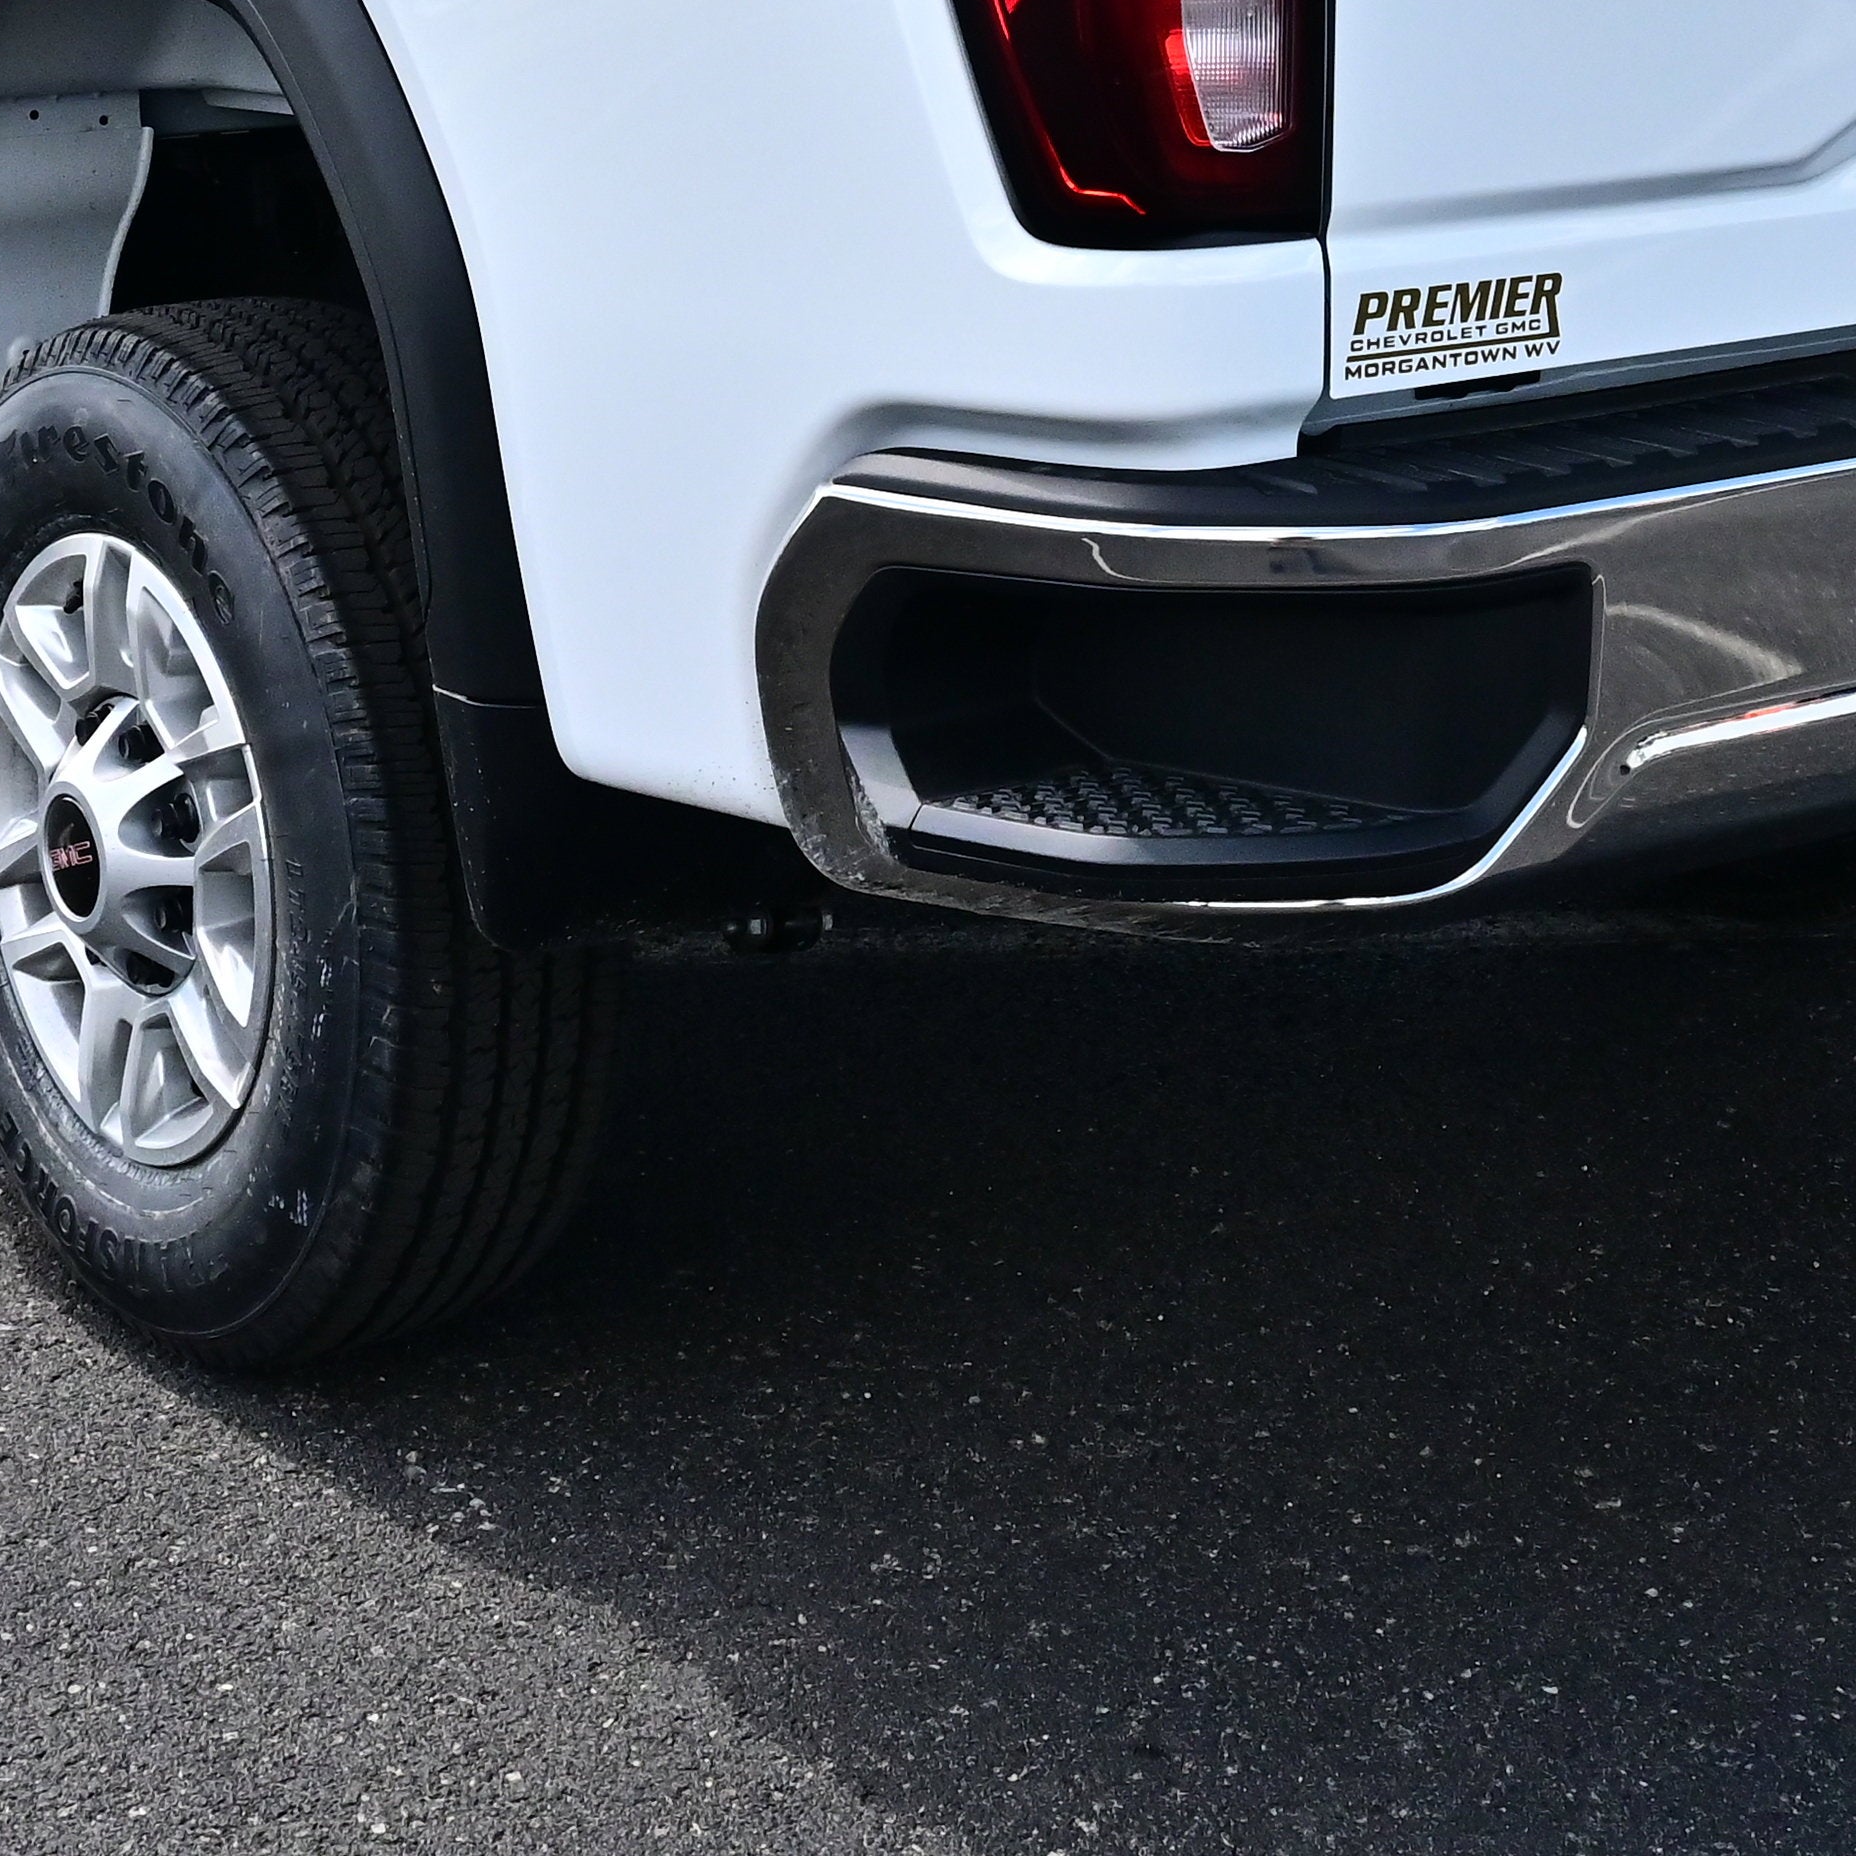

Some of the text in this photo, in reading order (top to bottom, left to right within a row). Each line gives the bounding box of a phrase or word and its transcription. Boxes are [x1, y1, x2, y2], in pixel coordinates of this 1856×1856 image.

[1352, 272, 1562, 338] PREMIER
[1350, 318, 1541, 352] CHEVROLET GMC
[1345, 341, 1561, 380] MORGANTOWN WV
[50, 840, 93, 871] GMC
